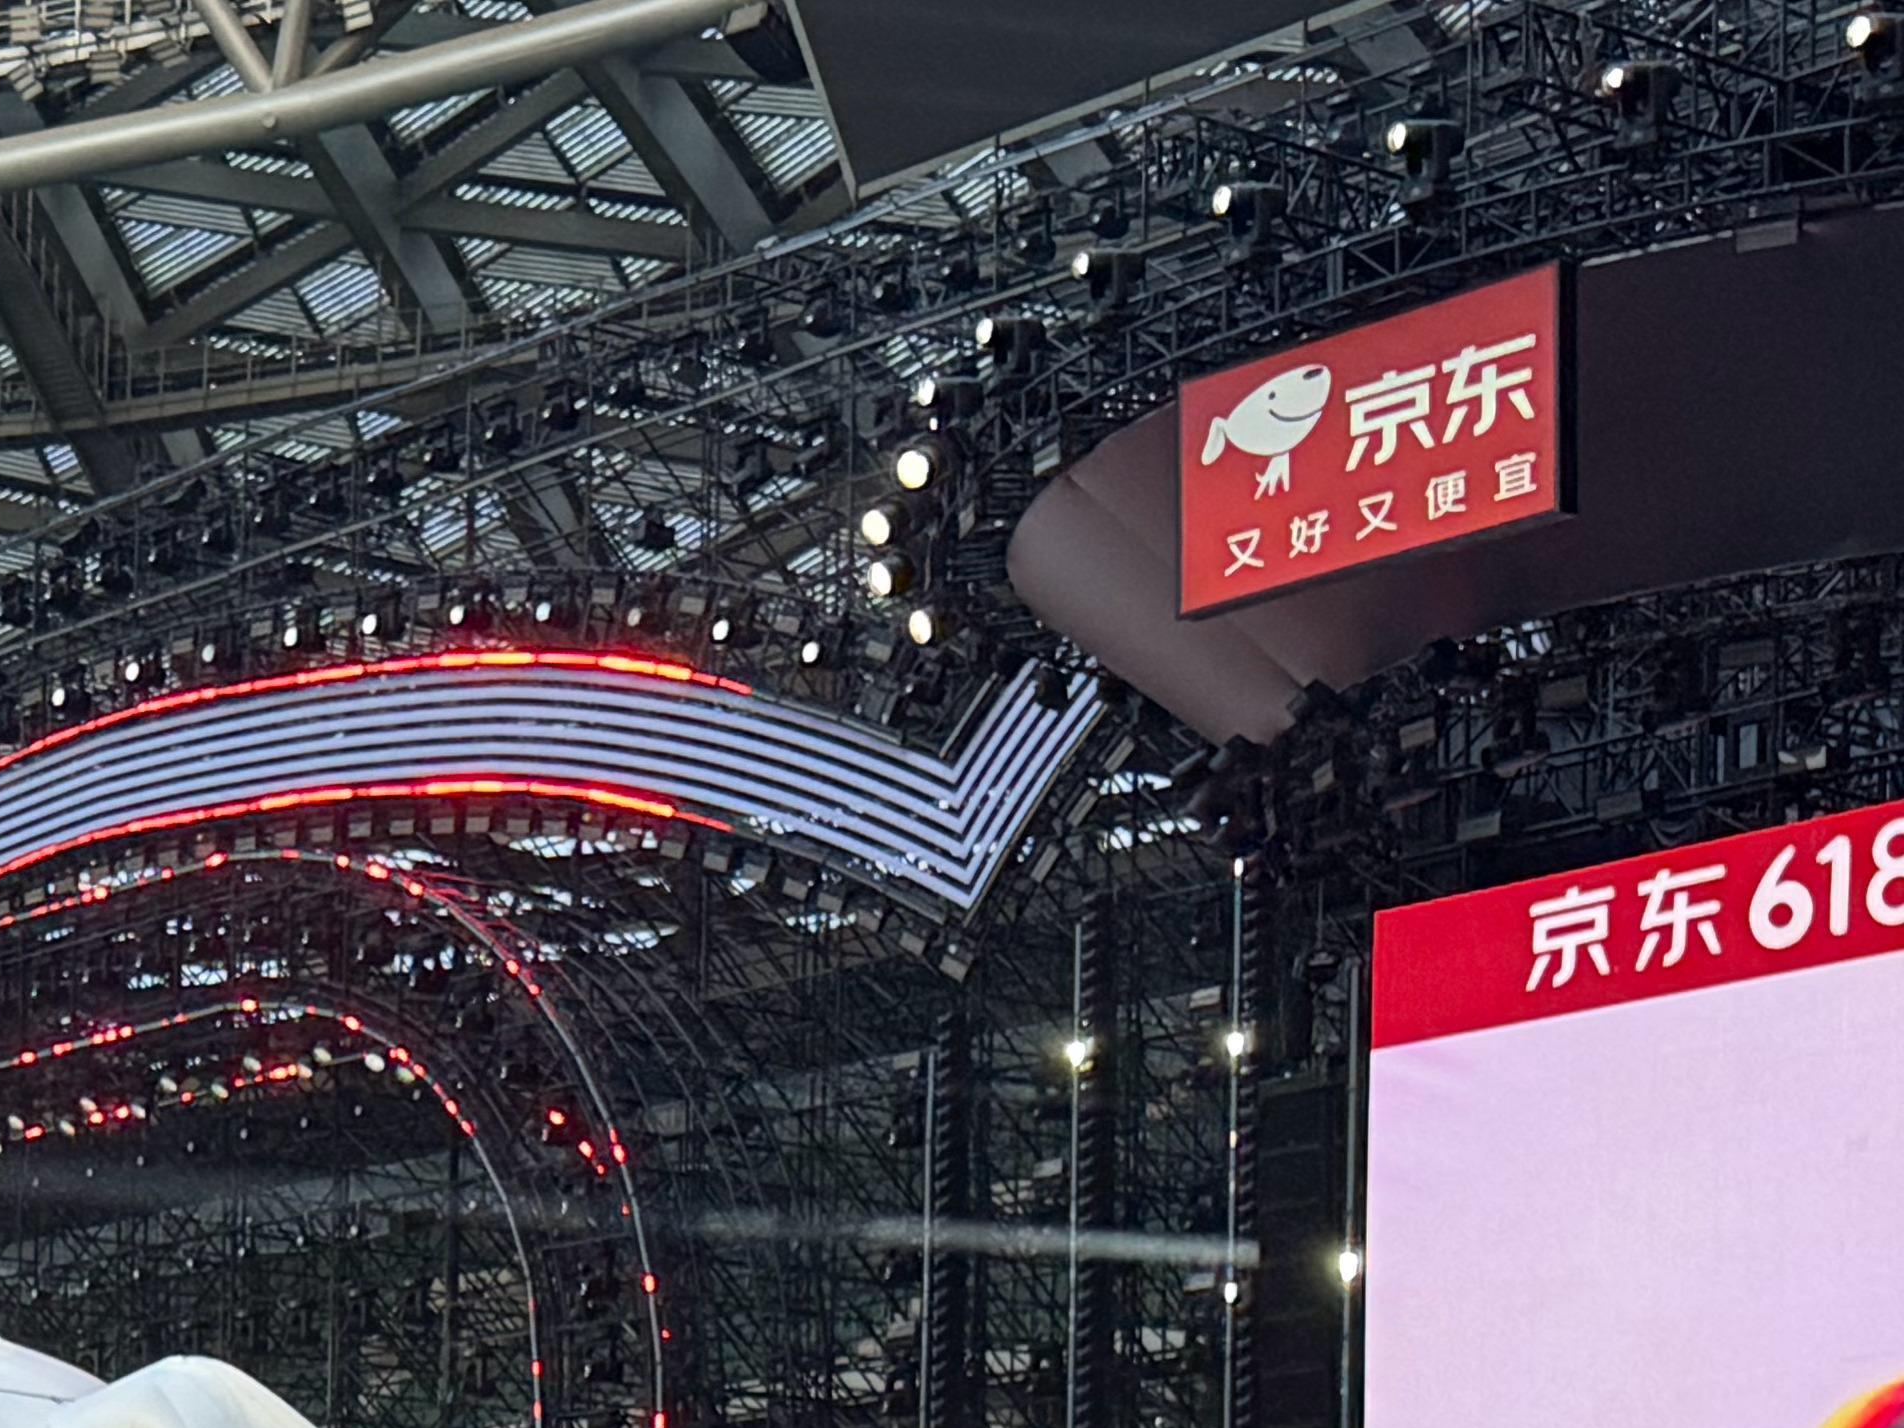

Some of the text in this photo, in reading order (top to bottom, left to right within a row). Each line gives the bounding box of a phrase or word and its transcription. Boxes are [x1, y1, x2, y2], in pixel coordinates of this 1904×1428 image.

[1344, 333, 1537, 472] 京东
[1222, 451, 1539, 577] 又好又便宜
